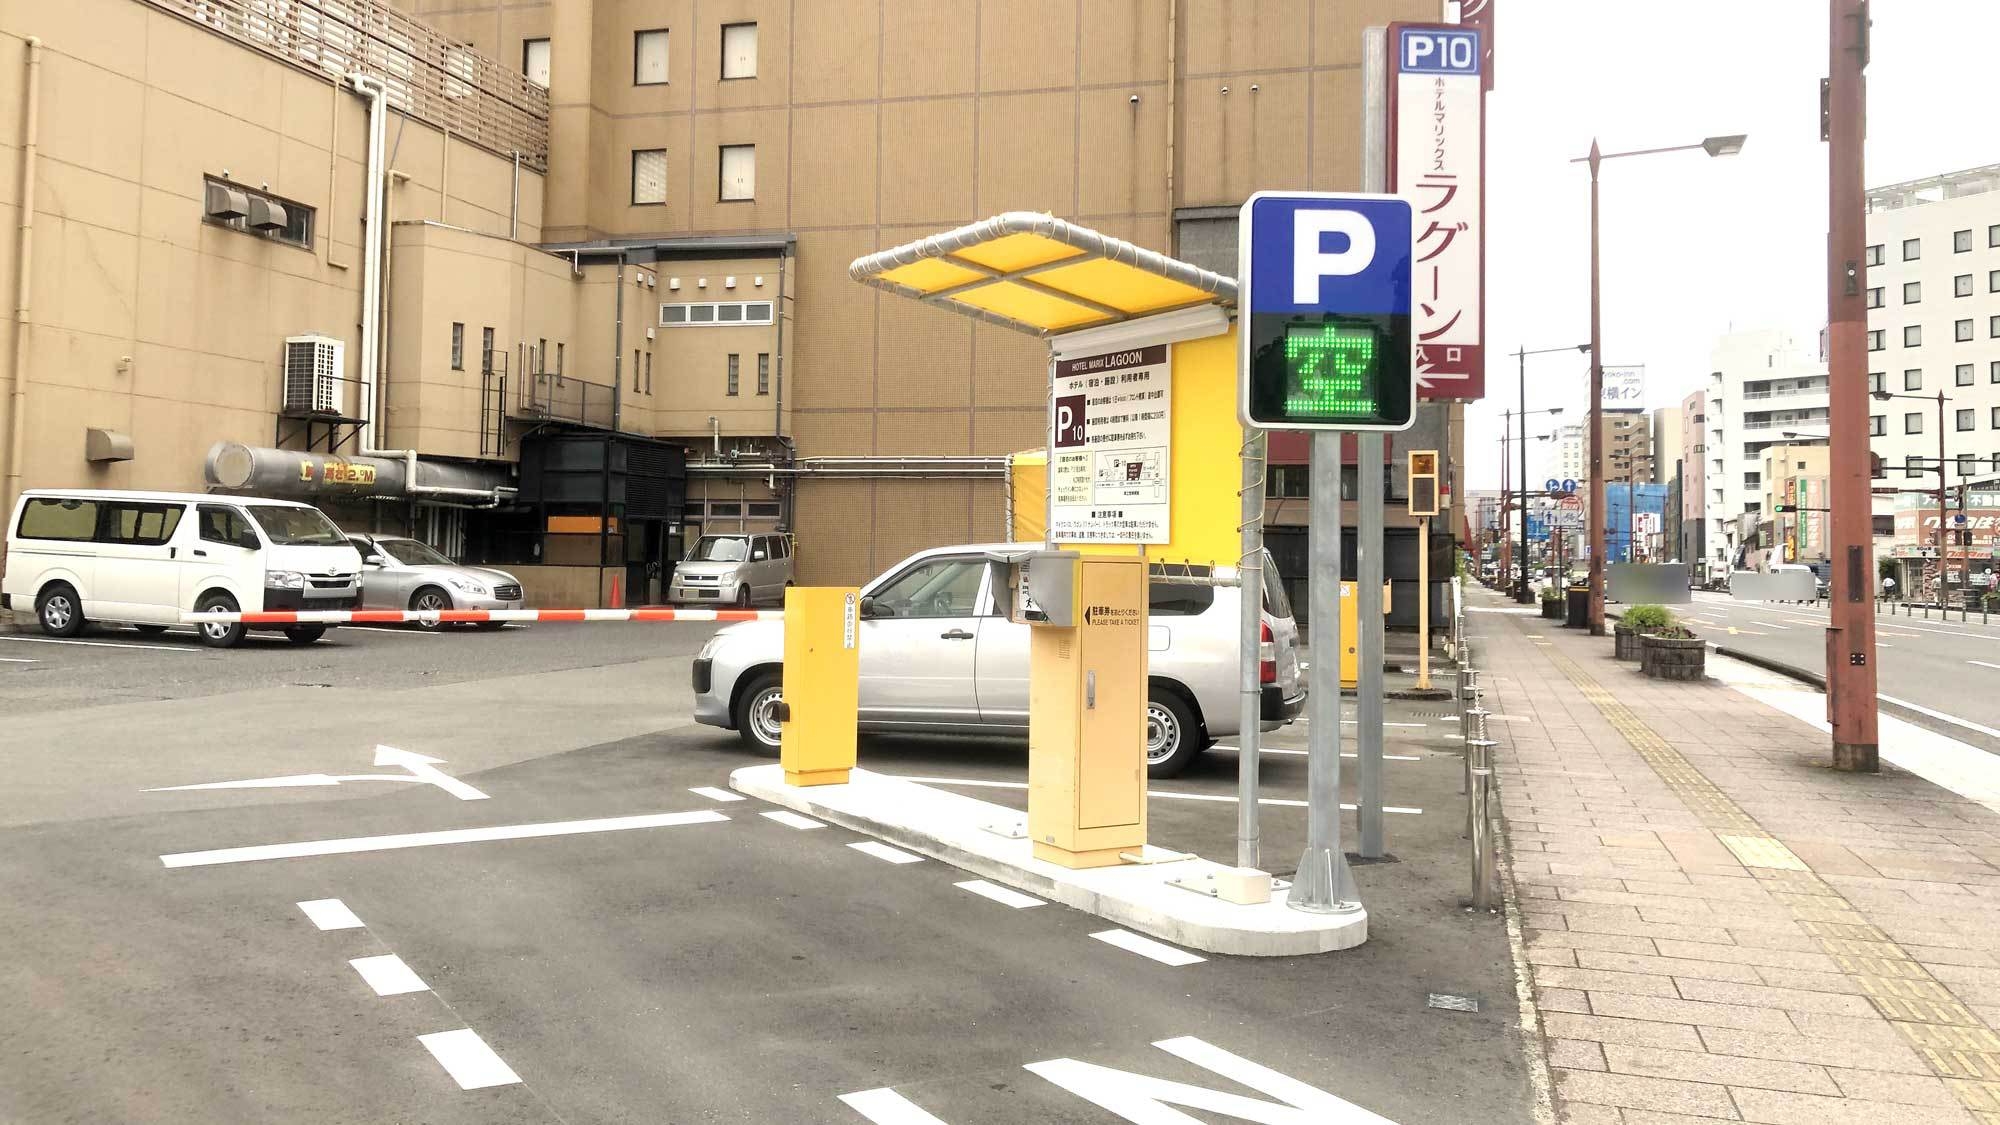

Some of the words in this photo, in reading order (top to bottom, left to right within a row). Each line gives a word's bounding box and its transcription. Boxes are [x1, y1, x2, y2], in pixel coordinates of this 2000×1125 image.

[1407, 35, 1472, 68] P10
[1433, 76, 1446, 171] ホテルマリックス
[1293, 208, 1377, 304] P
[1415, 174, 1469, 341] ラグーン
[1071, 361, 1088, 372] HOTEL
[1088, 358, 1105, 369] MARIX
[1104, 350, 1143, 368] LAGOON
[1285, 326, 1373, 412] 空
[1057, 405, 1073, 443] P
[1072, 425, 1084, 441] 10
